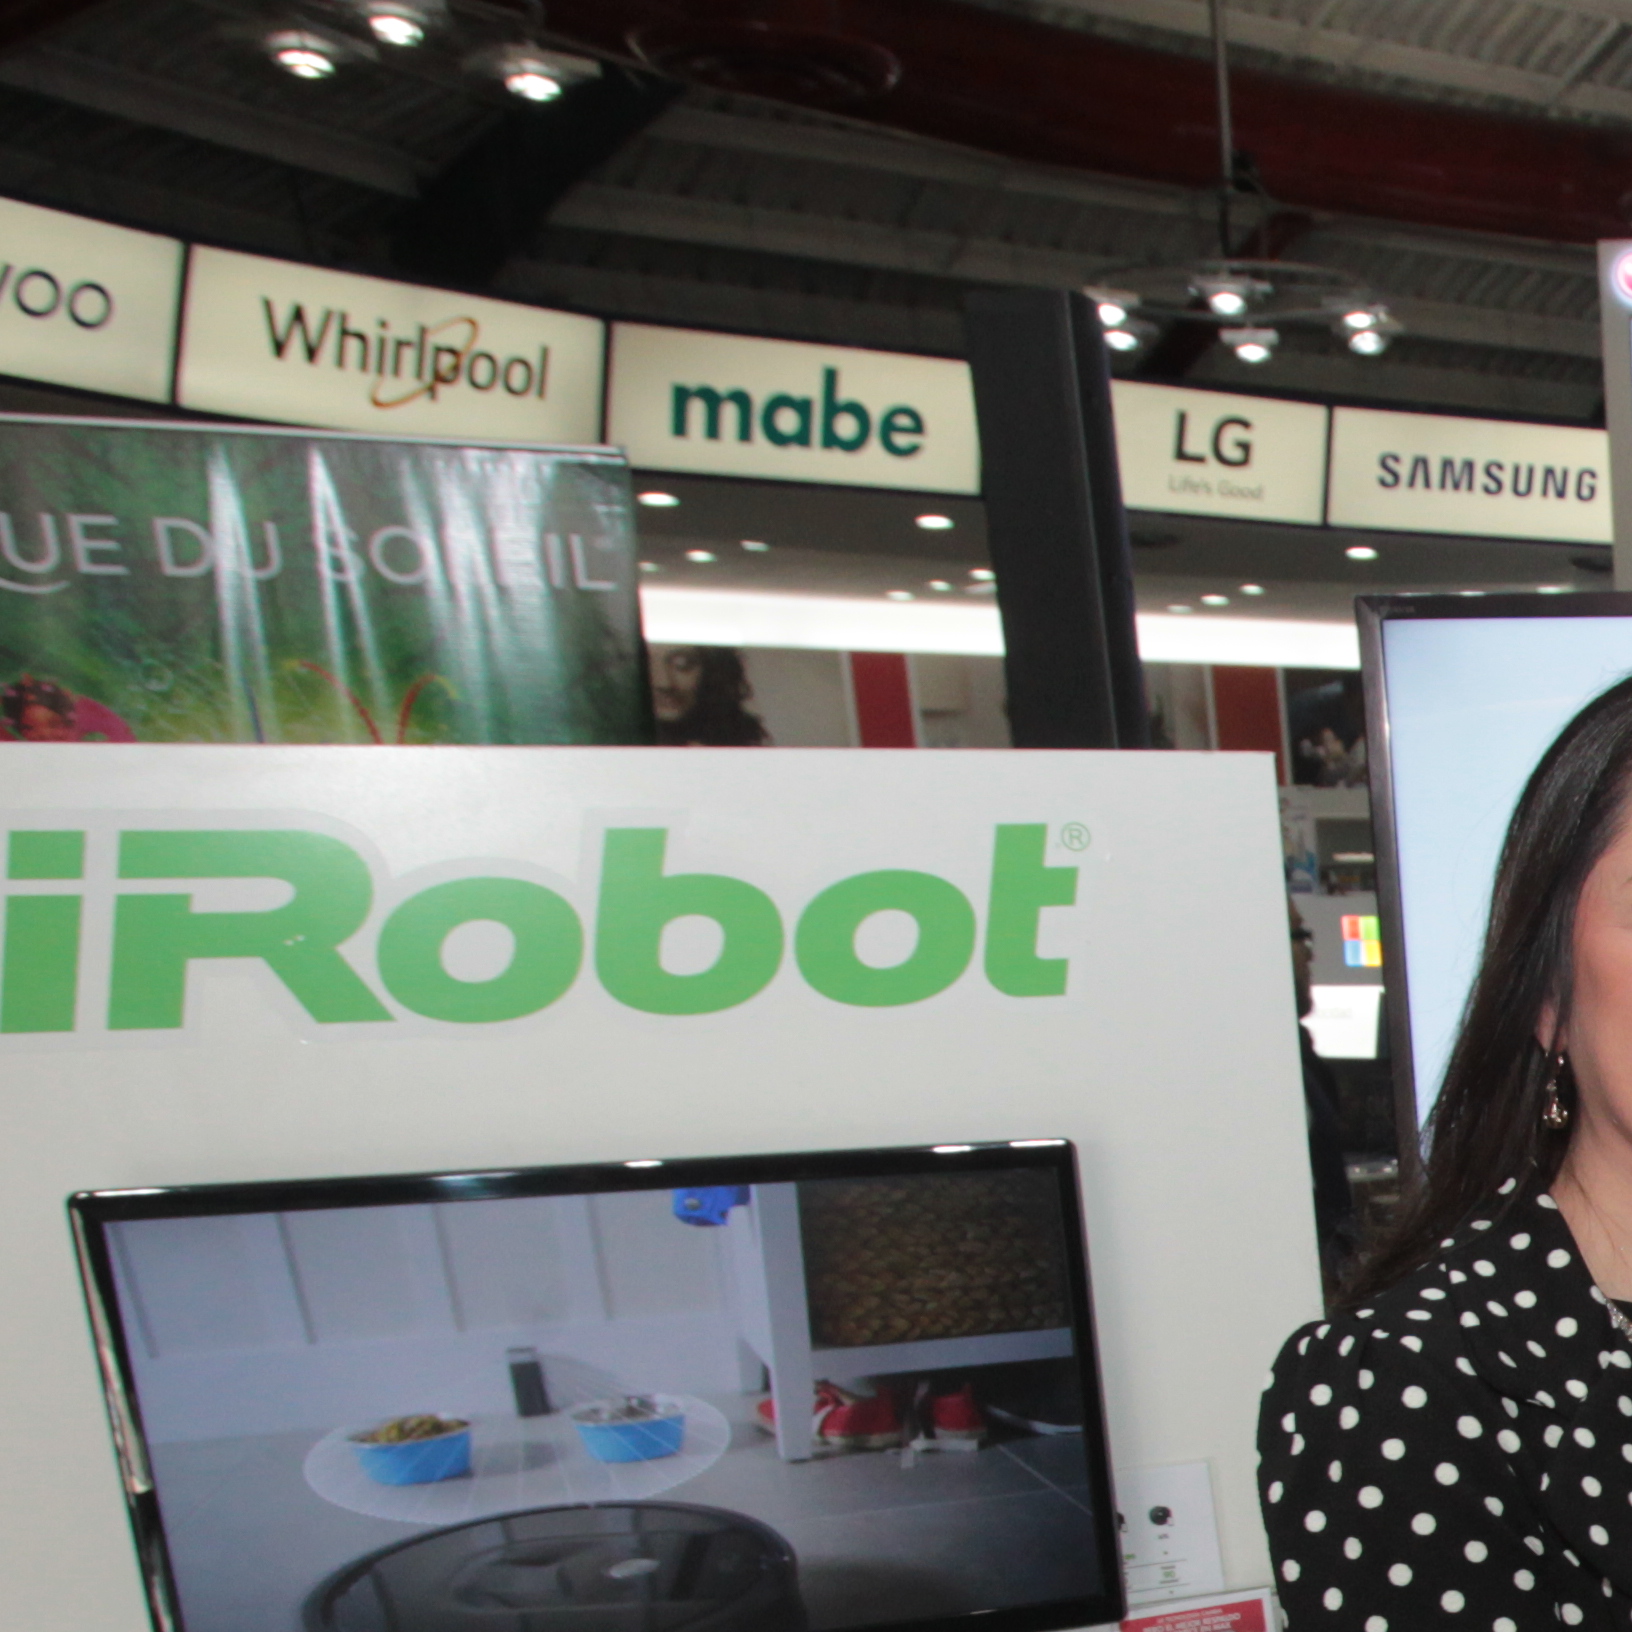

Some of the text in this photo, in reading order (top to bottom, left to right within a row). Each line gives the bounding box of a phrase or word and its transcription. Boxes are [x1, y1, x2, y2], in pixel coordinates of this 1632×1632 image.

[262, 296, 549, 401] Whirlpool
[670, 367, 926, 457] mabe
[1175, 408, 1253, 468] LG
[1377, 451, 1599, 503] SAMSUNG
[152, 515, 283, 581] DU
[0, 821, 1080, 1033] iRobot
